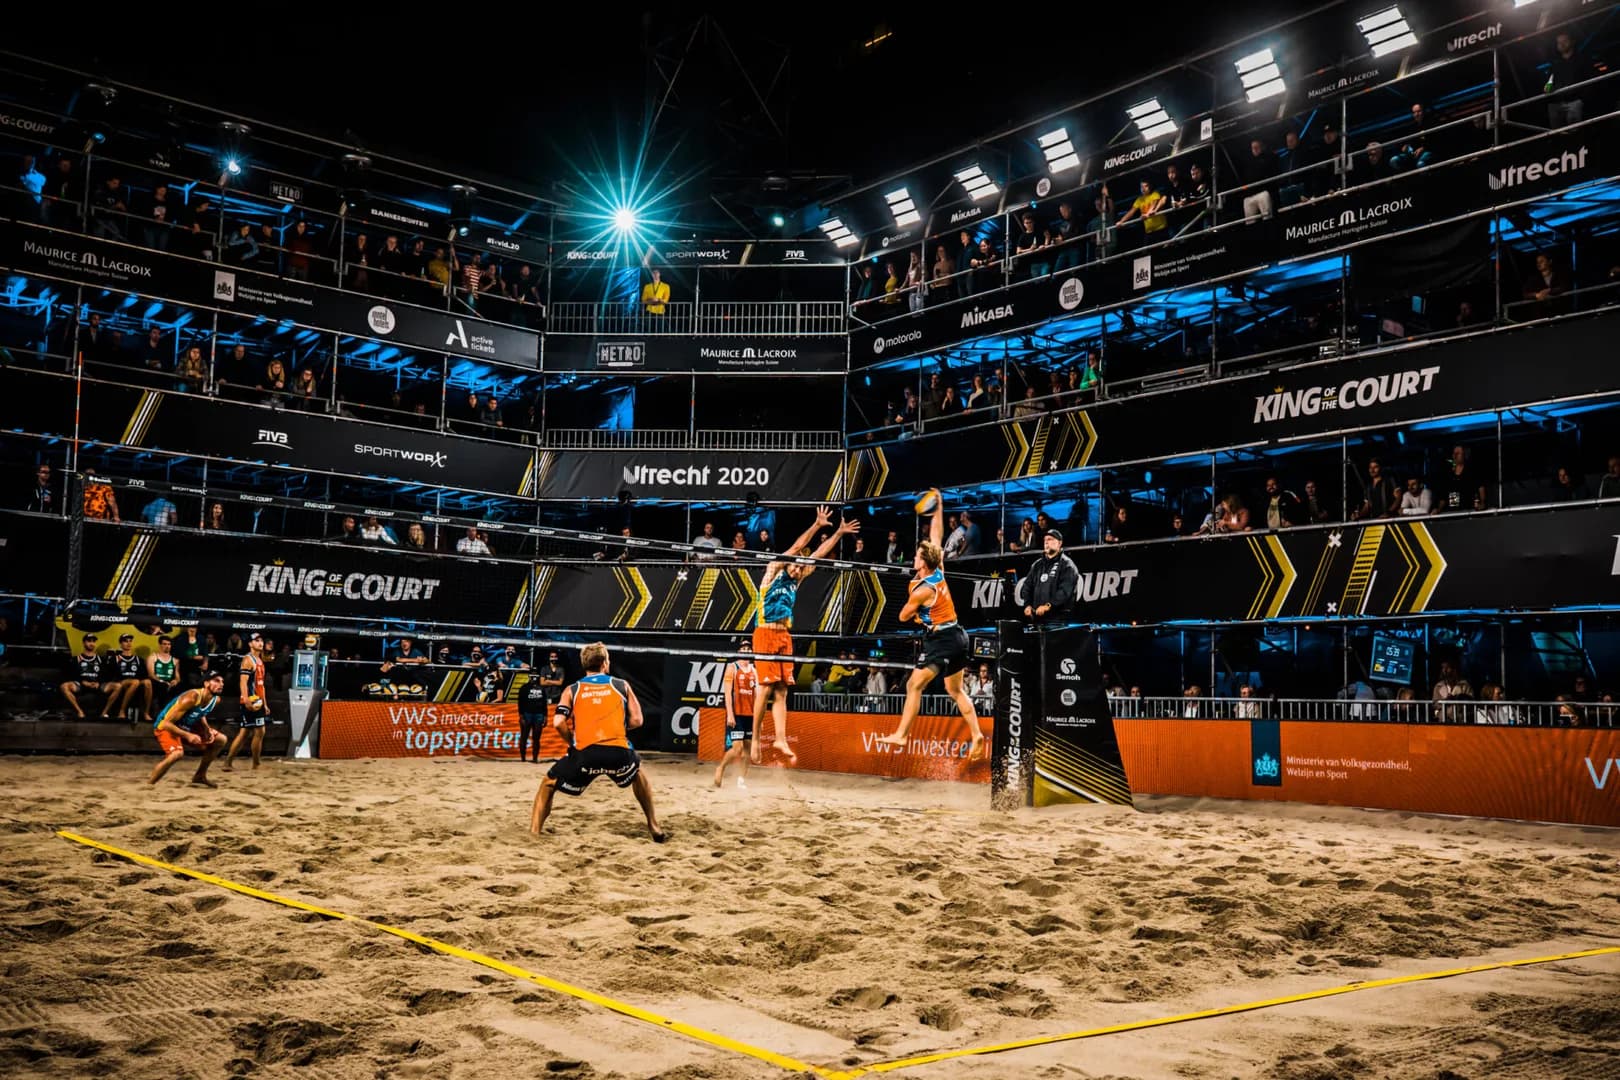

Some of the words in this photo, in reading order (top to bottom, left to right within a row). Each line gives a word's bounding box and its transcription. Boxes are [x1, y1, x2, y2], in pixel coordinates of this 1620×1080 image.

[1446, 22, 1502, 52] Utrecht
[1488, 145, 1588, 190] Utrecht
[1285, 217, 1336, 241] MAURICE
[1358, 196, 1413, 221] LACROIX
[23, 240, 78, 262] MAURICE
[101, 256, 152, 278] LACROIX
[470, 343, 495, 354] tickets
[471, 335, 493, 345] active
[885, 330, 922, 348] motorola
[700, 348, 740, 358] MAURICE
[756, 348, 797, 358] LACROIX
[1323, 386, 1337, 397] OF
[1338, 365, 1440, 410] COURT
[1253, 386, 1322, 424] KING
[1321, 399, 1338, 410] THE
[354, 444, 448, 468] SPORTWORX
[623, 464, 710, 486] Utrecht
[717, 466, 769, 486] 2020
[245, 564, 328, 597] KING
[328, 574, 343, 582] OF
[342, 572, 440, 602] COURT
[325, 586, 342, 596] THE
[388, 706, 438, 726] VWS
[440, 712, 504, 726] investeert
[1008, 678, 1022, 738] COURT
[392, 730, 402, 740] in
[1286, 756, 1324, 766] Ministerie
[1341, 758, 1412, 772] Volksgezondheid,
[1286, 768, 1314, 780] Welzijn
[1315, 770, 1326, 778] en
[1326, 770, 1348, 781] Sport
